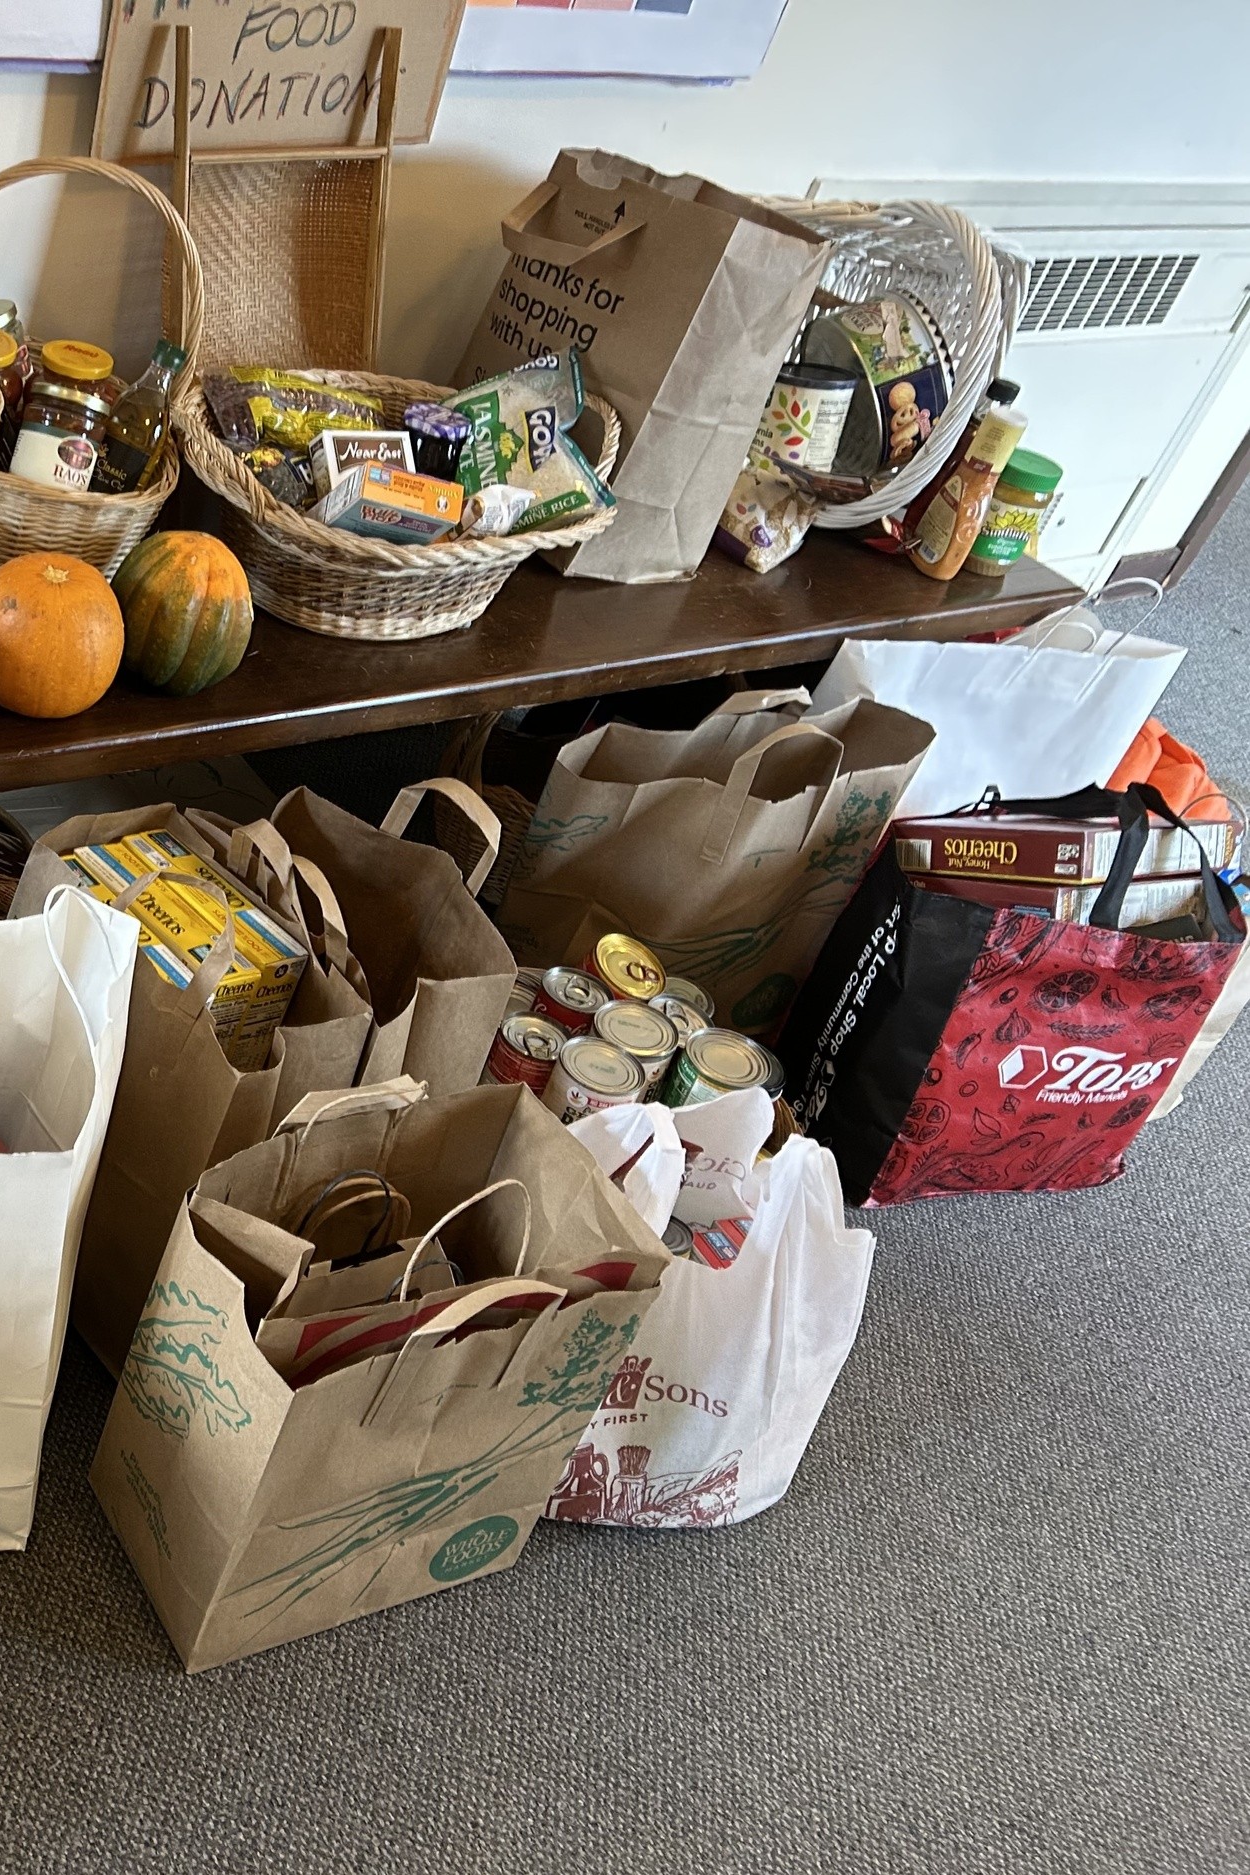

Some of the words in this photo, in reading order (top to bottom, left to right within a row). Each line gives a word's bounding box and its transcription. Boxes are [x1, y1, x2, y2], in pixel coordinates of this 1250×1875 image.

[231, 1, 356, 65] FOOD
[585, 278, 625, 314] for
[500, 278, 598, 353] shopping
[490, 312, 523, 350] with
[339, 442, 377, 461] Near
[551, 494, 579, 514] RICE
[510, 506, 548, 533] SMINE
[944, 838, 1018, 865] Cheerios
[948, 857, 963, 868] Nut
[965, 857, 990, 870] Honey
[857, 943, 873, 970] the
[216, 980, 255, 998] Cheerios
[256, 980, 294, 999] Cheerios
[817, 971, 859, 1052] Community
[830, 1009, 857, 1056] Shop
[1036, 1089, 1085, 1106] Friendly
[645, 1375, 729, 1418] Sons
[603, 1413, 648, 1428] FIRST
[442, 1541, 501, 1568] FOODS
[446, 1529, 507, 1556] WHOLE
